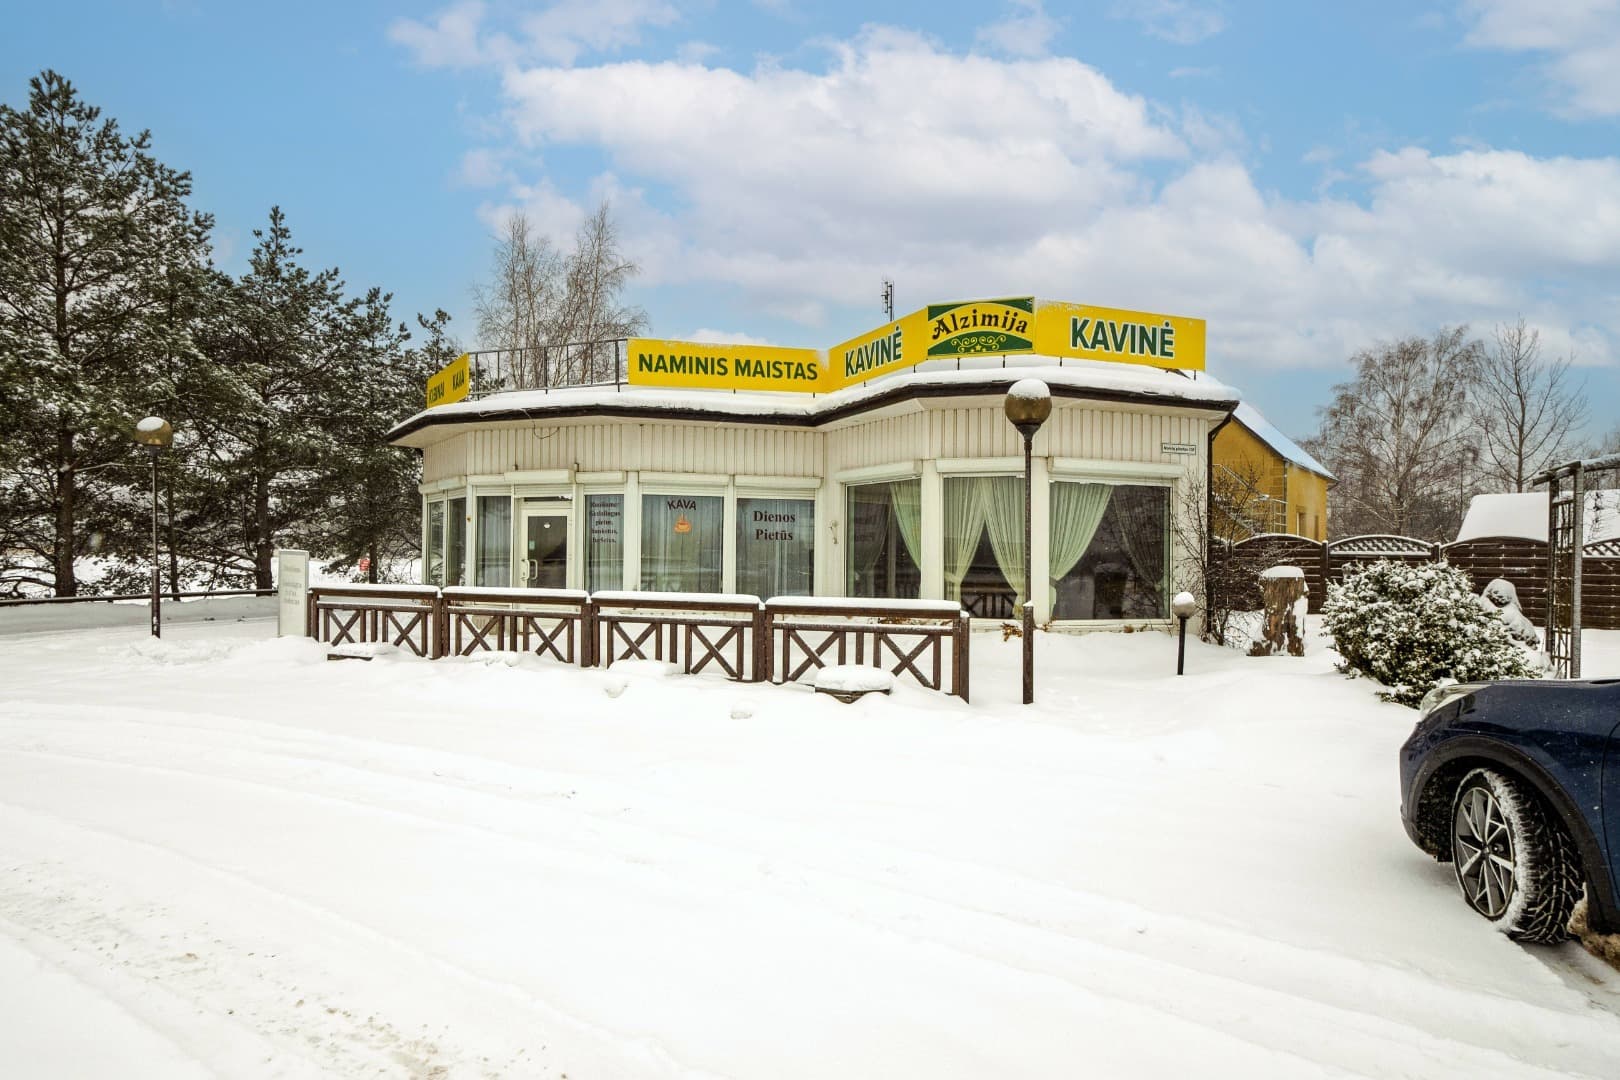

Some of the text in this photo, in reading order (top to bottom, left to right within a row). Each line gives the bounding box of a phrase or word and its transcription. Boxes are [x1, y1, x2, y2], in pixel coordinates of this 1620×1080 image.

[932, 308, 1028, 340] Alzimija
[1072, 317, 1174, 358] KAVINĖ
[844, 326, 903, 376] KAVINĖ
[638, 353, 818, 381] NAMINIS MAISTAS
[667, 499, 697, 511] KAVA
[753, 510, 796, 523] Dienos
[755, 528, 794, 541] Pietūs
